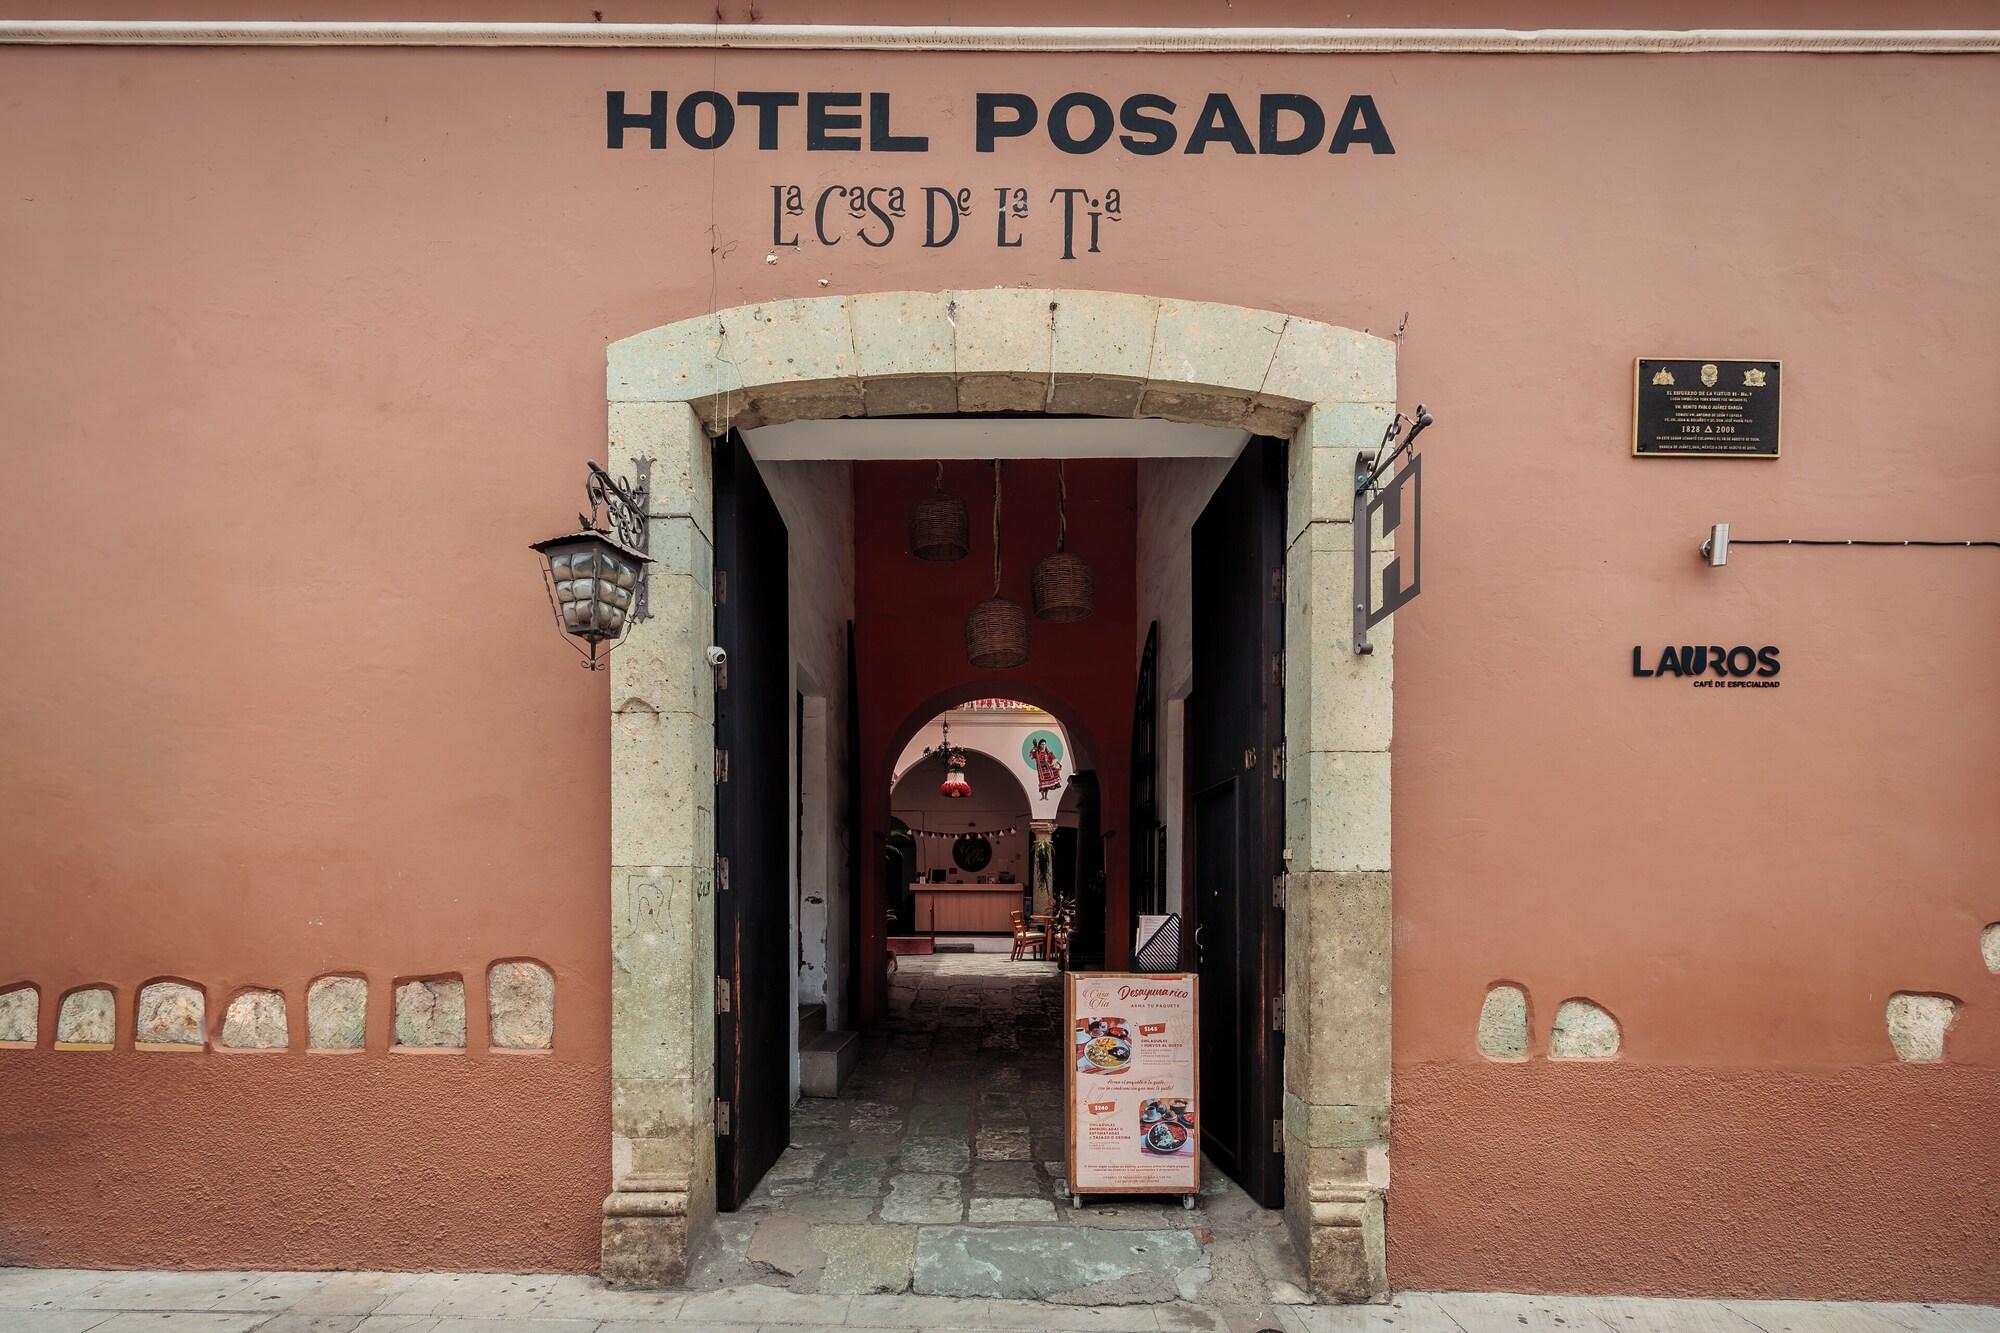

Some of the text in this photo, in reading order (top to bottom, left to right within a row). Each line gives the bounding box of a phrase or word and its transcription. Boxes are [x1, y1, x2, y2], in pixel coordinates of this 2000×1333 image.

[606, 91, 1396, 155] HOTEL POSADA
[769, 184, 804, 246] La
[920, 186, 972, 248] De
[994, 187, 1029, 247] La
[1681, 425, 1735, 434] 1828 2008
[1632, 645, 1780, 677] LAUROS
[1693, 679, 1713, 688] CAFÉ
[1727, 681, 1780, 689] ESPECIALIDAD
[1117, 985, 1189, 1001] Desayuna rico
